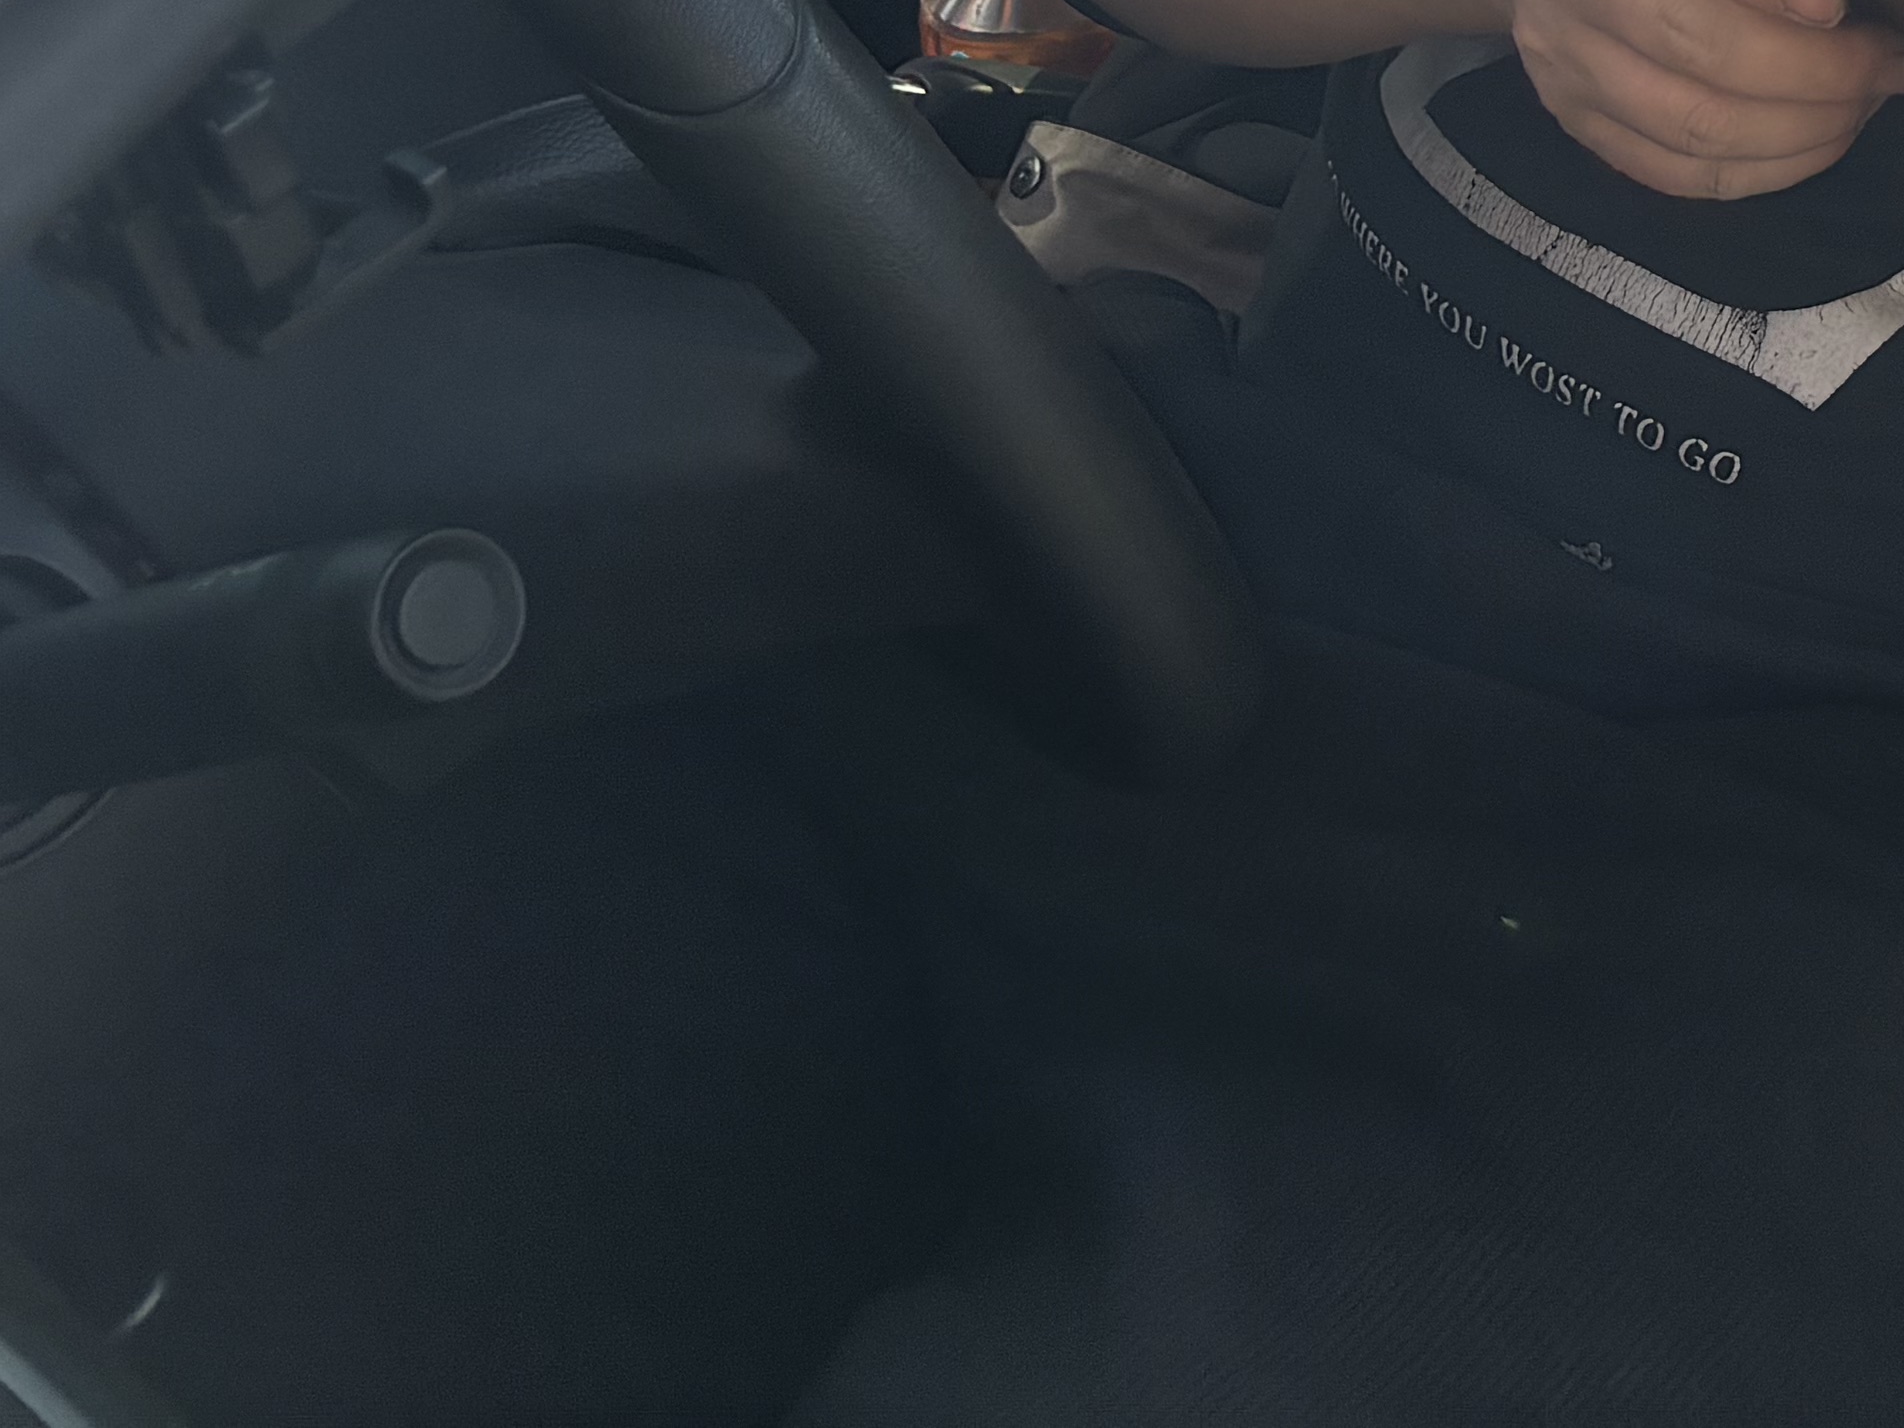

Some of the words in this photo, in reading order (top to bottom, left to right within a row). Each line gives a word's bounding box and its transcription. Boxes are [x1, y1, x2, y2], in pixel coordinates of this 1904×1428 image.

[1341, 191, 1409, 295] WHERE
[1421, 282, 1487, 350] YOU
[1500, 336, 1602, 417] WOST
[1614, 402, 1666, 452] TO
[1678, 438, 1742, 486] GO
